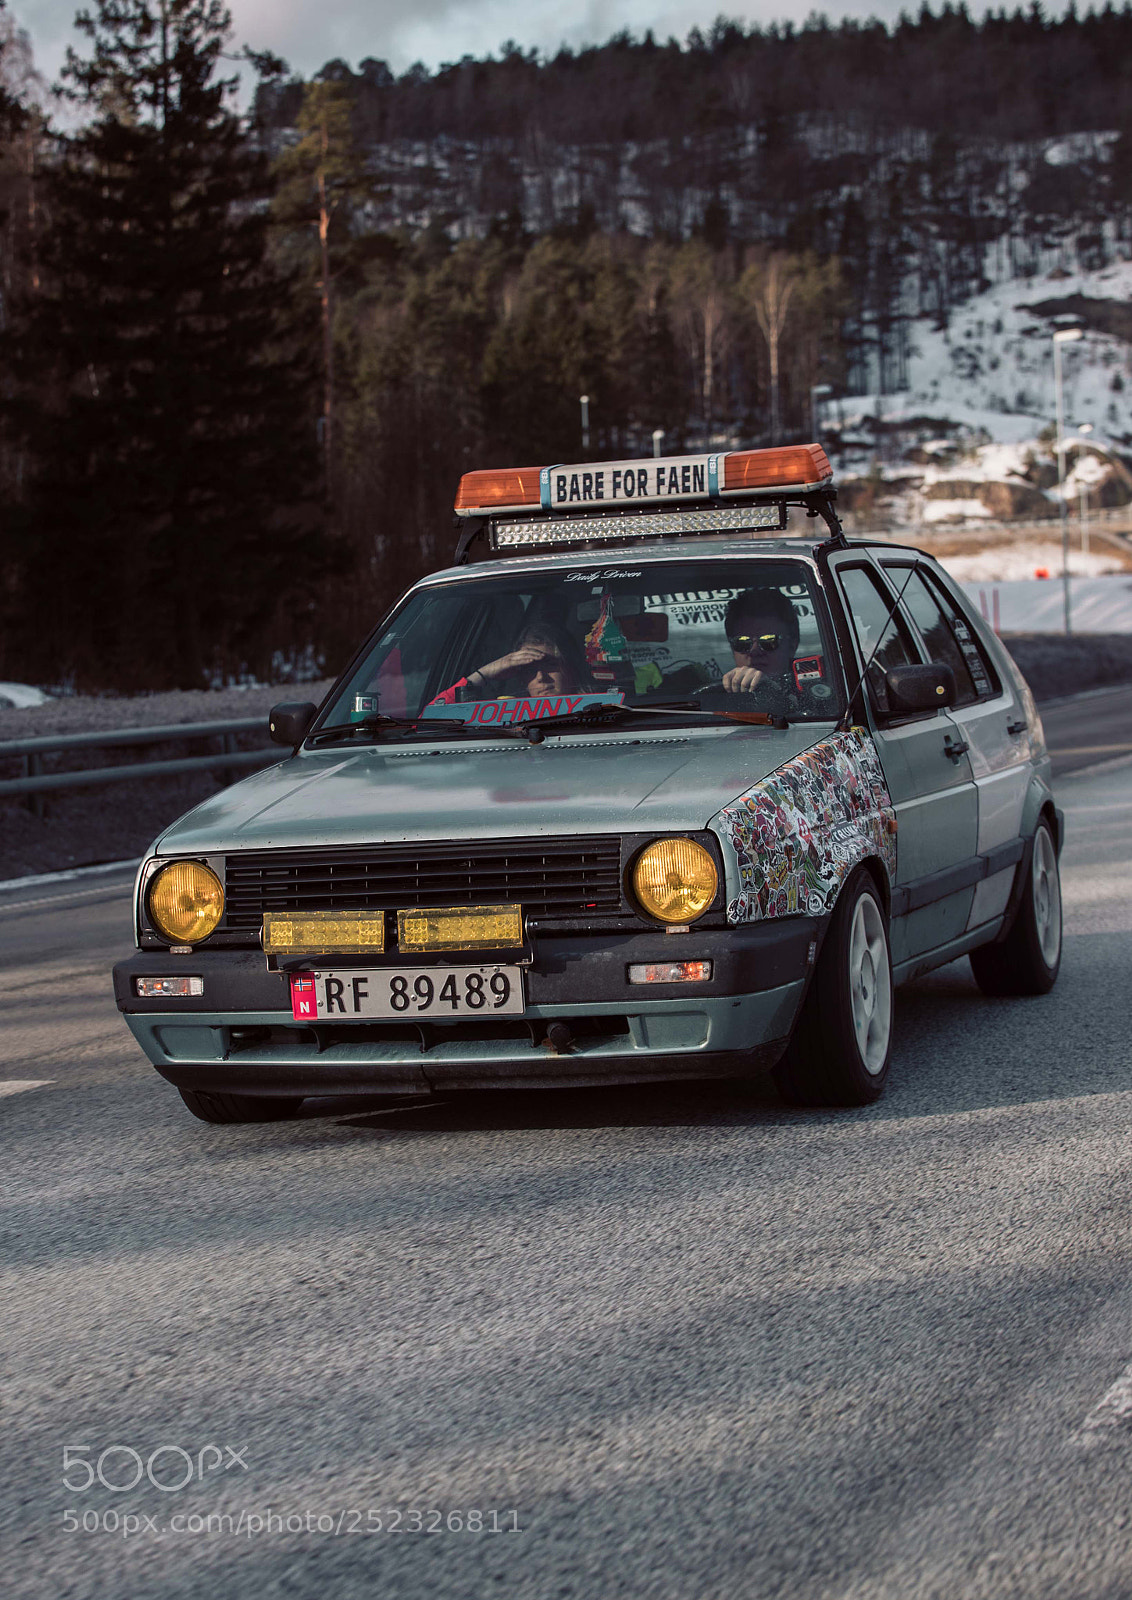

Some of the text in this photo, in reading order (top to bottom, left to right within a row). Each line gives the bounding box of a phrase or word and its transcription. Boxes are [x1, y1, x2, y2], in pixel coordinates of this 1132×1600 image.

[557, 464, 705, 502] BARE FOR FAEN
[464, 698, 583, 724] JOHNNY
[299, 1001, 311, 1013] N
[324, 972, 511, 1013] RF 89489
